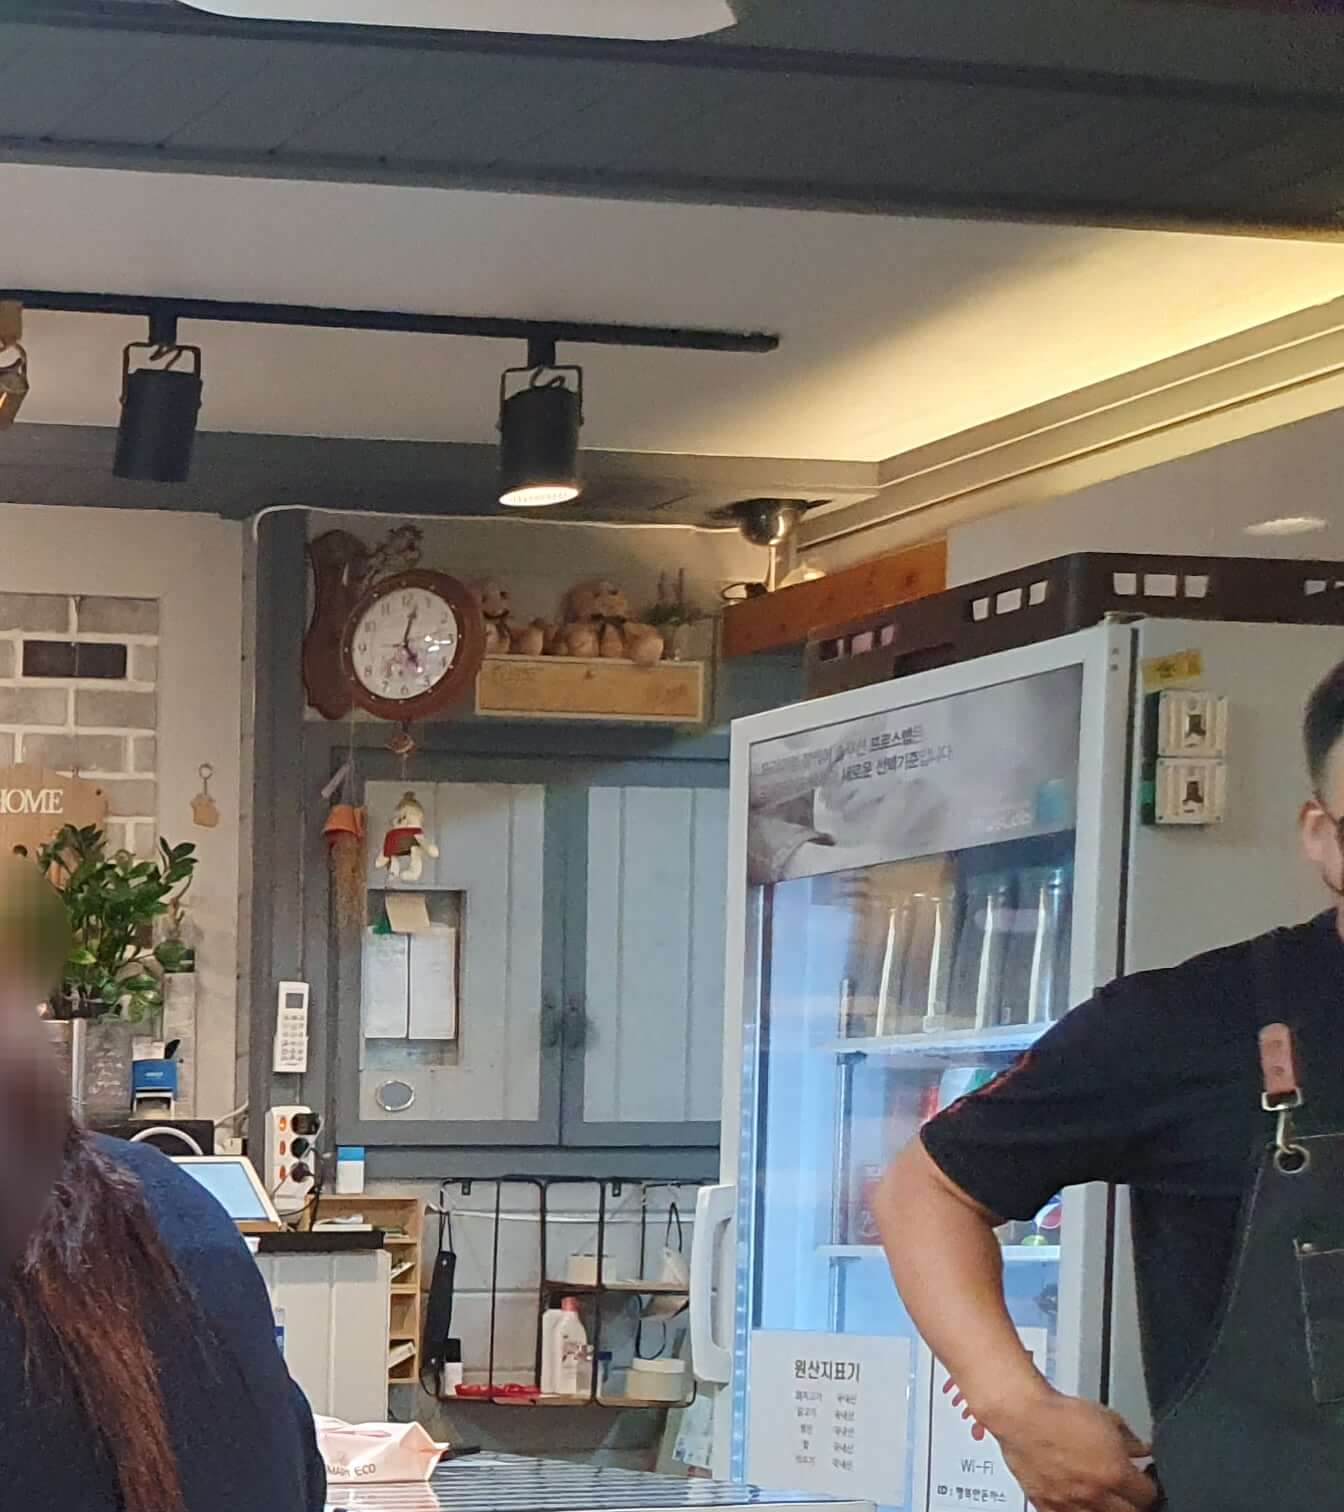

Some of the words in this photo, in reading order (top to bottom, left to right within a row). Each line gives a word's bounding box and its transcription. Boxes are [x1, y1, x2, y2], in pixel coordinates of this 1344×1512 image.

[794, 1359, 861, 1383] 원산지표기
[354, 1463, 377, 1477] ECO
[961, 1457, 994, 1475] Wi-Fi
